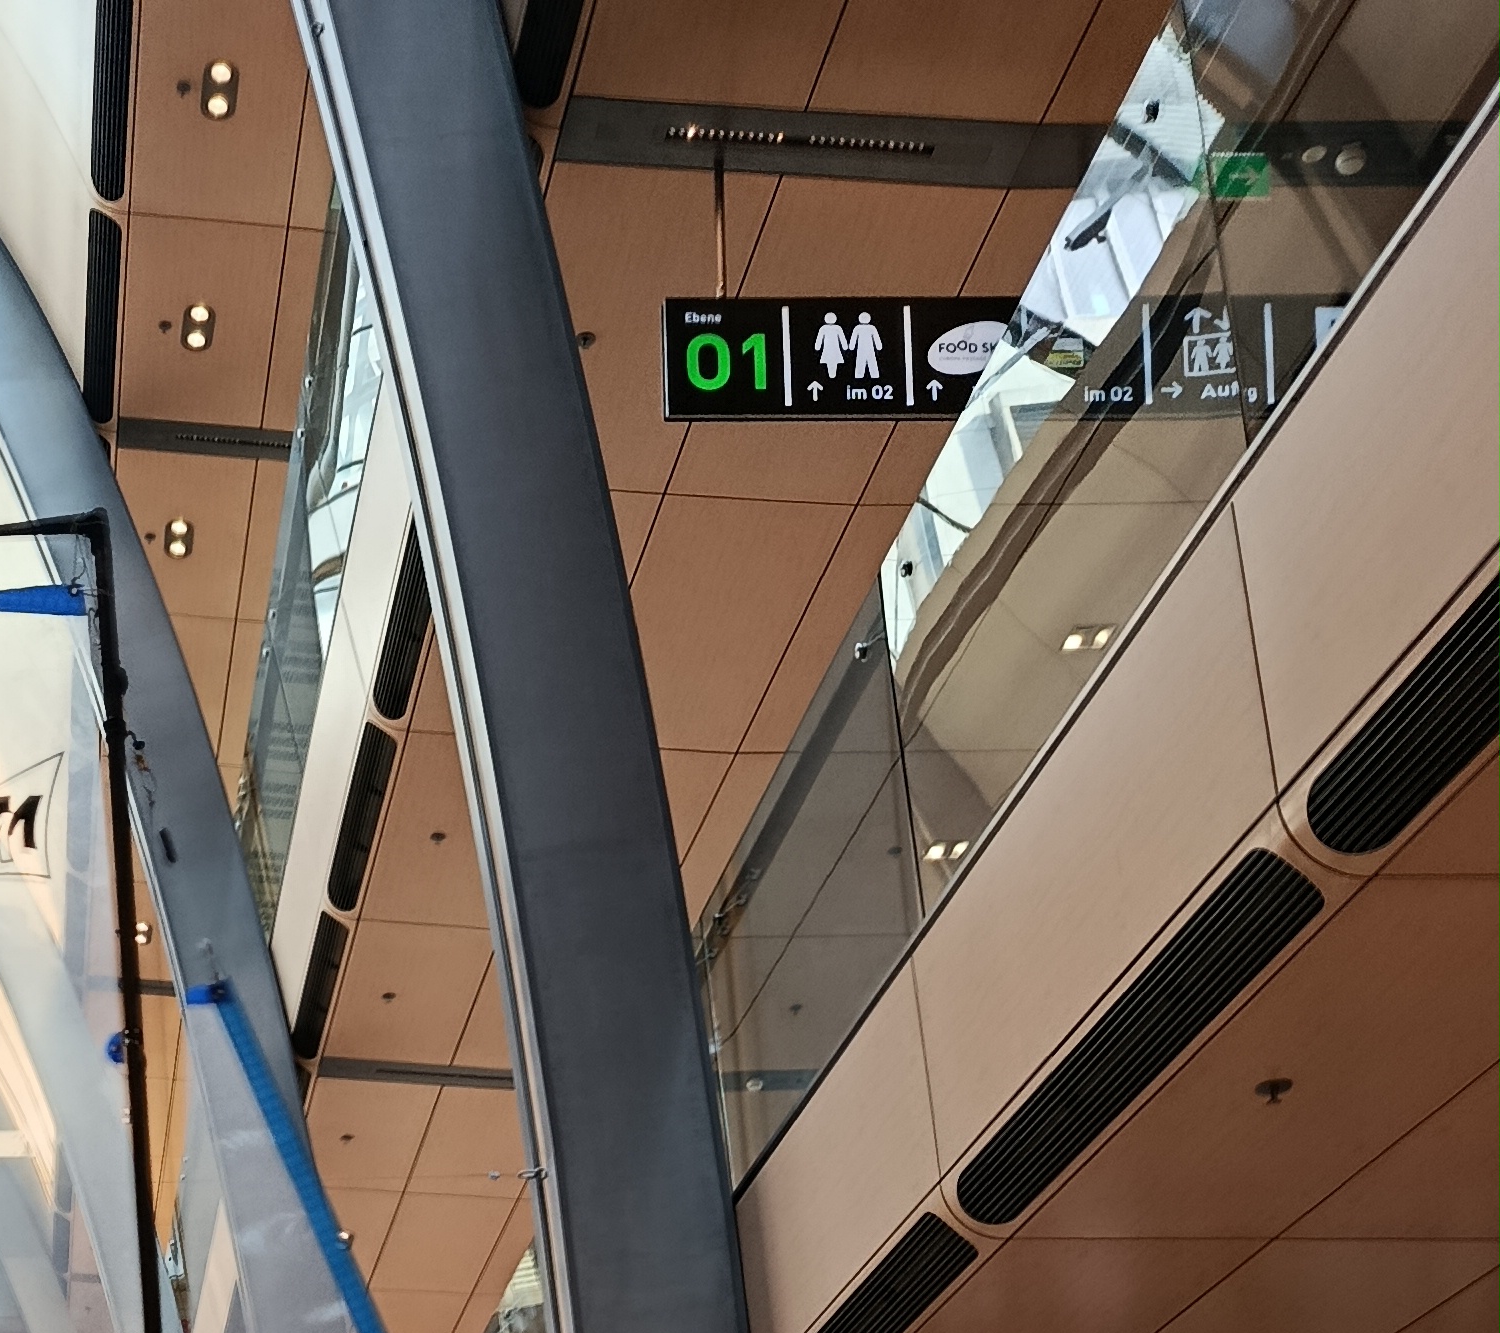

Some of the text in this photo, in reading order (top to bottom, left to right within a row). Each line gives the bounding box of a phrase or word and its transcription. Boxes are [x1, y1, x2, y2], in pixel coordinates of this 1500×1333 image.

[685, 311, 722, 324] Ebene
[938, 340, 999, 354] FOOD SK
[686, 333, 767, 391] 01
[846, 385, 894, 400] im 02
[1084, 386, 1134, 402] im 02
